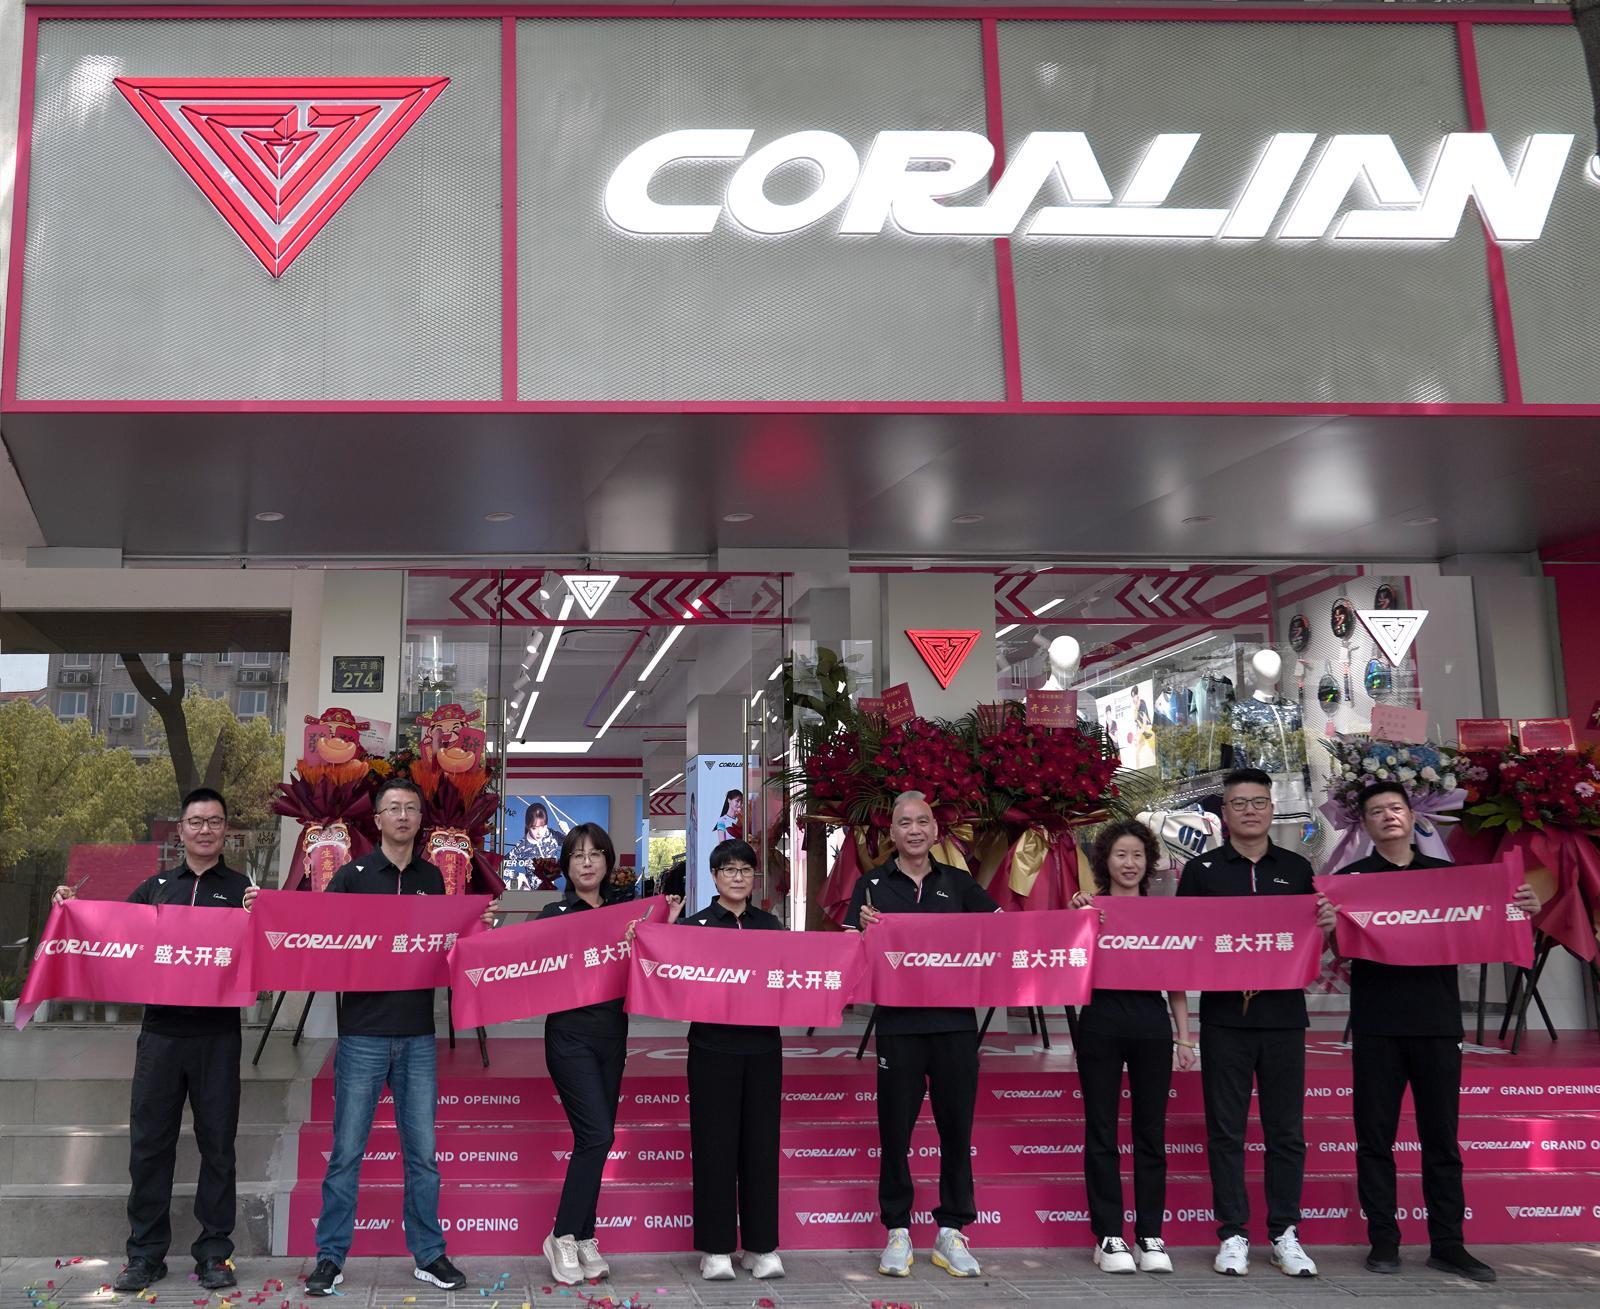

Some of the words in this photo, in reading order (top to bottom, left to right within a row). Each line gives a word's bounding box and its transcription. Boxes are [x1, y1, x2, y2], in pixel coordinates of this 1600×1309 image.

[604, 128, 1575, 242] CORALIAN
[342, 672, 374, 688] 274
[1372, 905, 1484, 926] CORALIAN
[284, 933, 378, 950] CORALIAN
[1098, 935, 1197, 950] CORALIAN
[1214, 932, 1295, 953] 盛大开幕
[45, 938, 138, 959] CORALIAN
[583, 940, 631, 967] 盛大开
[154, 944, 232, 967] 盛大开幕
[903, 951, 995, 967] CORALIAN
[1011, 947, 1088, 969] 盛大开幕
[483, 953, 568, 982] CORALIAN
[656, 963, 750, 984] CORALIAN
[766, 969, 842, 990] 盛大开幕
[1004, 1089, 1062, 1098] CORALIAN
[1305, 1087, 1331, 1097] AND
[1500, 1086, 1544, 1095] GRAND
[1547, 1085, 1600, 1094] OPENING
[463, 1095, 521, 1105] OPENING
[634, 1094, 680, 1104] GRAND
[785, 1092, 845, 1101] CORALIAN
[1022, 1145, 1084, 1154] CORALIAN
[1164, 1144, 1204, 1154] ENING
[1319, 1142, 1358, 1152] GRAN
[1470, 1141, 1531, 1149] CORALIAN
[1541, 1140, 1586, 1150] GRAND
[459, 1151, 519, 1162] OPENING
[637, 1150, 685, 1161] GRAND
[795, 1148, 857, 1157] CORALIAN
[1049, 1211, 1091, 1222] CORAL
[1177, 1209, 1215, 1222] OPEN
[1299, 1207, 1348, 1219] RALIAN
[1519, 1206, 1582, 1217] CORALIAN
[644, 1215, 693, 1228] GRAND
[808, 1212, 873, 1224] CORALIAN
[456, 1218, 519, 1232] OPENING
